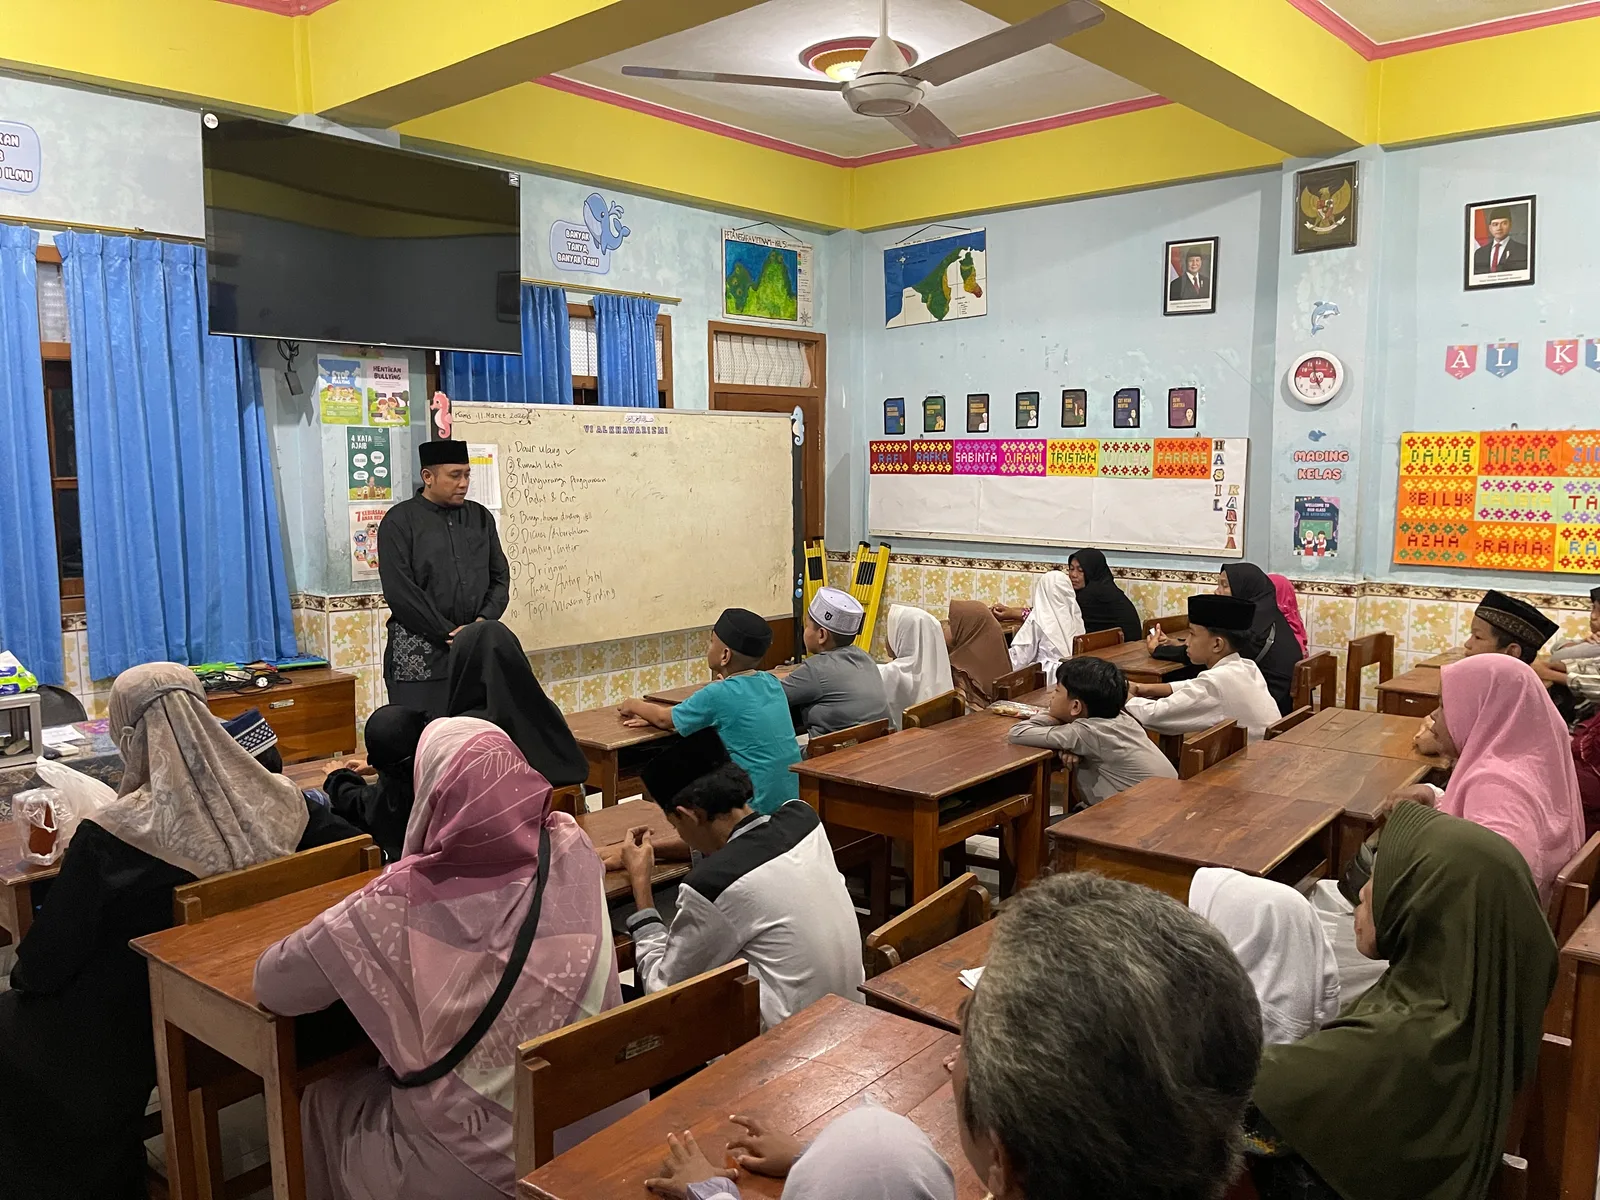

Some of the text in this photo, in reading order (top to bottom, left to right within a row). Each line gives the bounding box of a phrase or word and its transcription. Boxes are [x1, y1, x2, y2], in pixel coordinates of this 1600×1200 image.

[4, 167, 33, 183] ILMU
[565, 229, 590, 241] BANYAK
[557, 252, 599, 267] BANYAK TAHU
[332, 370, 350, 380] STOP
[584, 425, 593, 433] VI
[916, 452, 948, 463] RAFKA
[955, 452, 998, 463] SABINTA
[1051, 453, 1096, 464] TRISTAN
[1157, 453, 1208, 465] FARRAS
[1294, 450, 1349, 462] MADING
[1411, 449, 1471, 463] DAVIS
[1487, 447, 1550, 464] NIZAR
[1298, 468, 1342, 480] KELAS
[560, 491, 577, 503] Cair
[355, 511, 361, 522] 7
[1407, 534, 1459, 548] AZHA
[1483, 539, 1543, 555] RAMA
